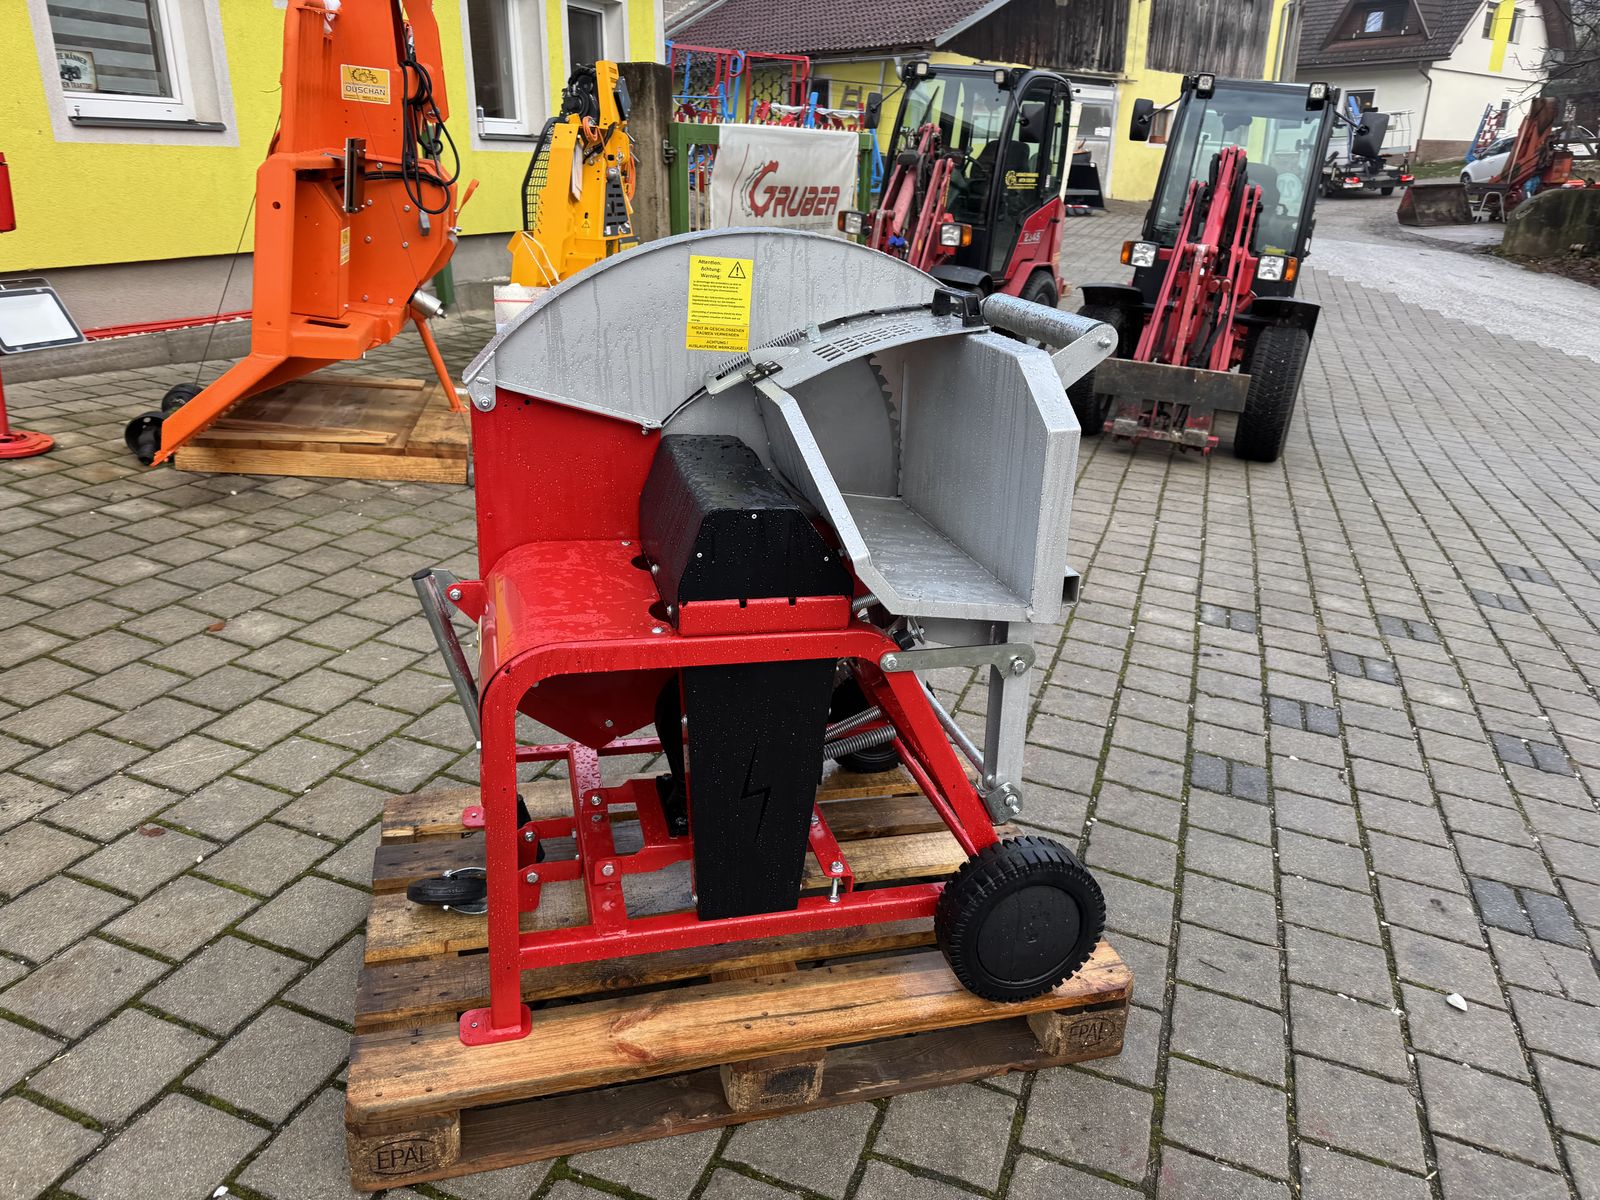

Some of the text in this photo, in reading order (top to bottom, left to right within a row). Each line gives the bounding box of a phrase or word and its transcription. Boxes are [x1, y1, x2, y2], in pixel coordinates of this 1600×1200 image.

[345, 85, 386, 96] OUSCHAN
[747, 159, 841, 218] GRUBER
[1069, 1021, 1104, 1041] EPAL
[377, 1145, 432, 1170] EPAL
